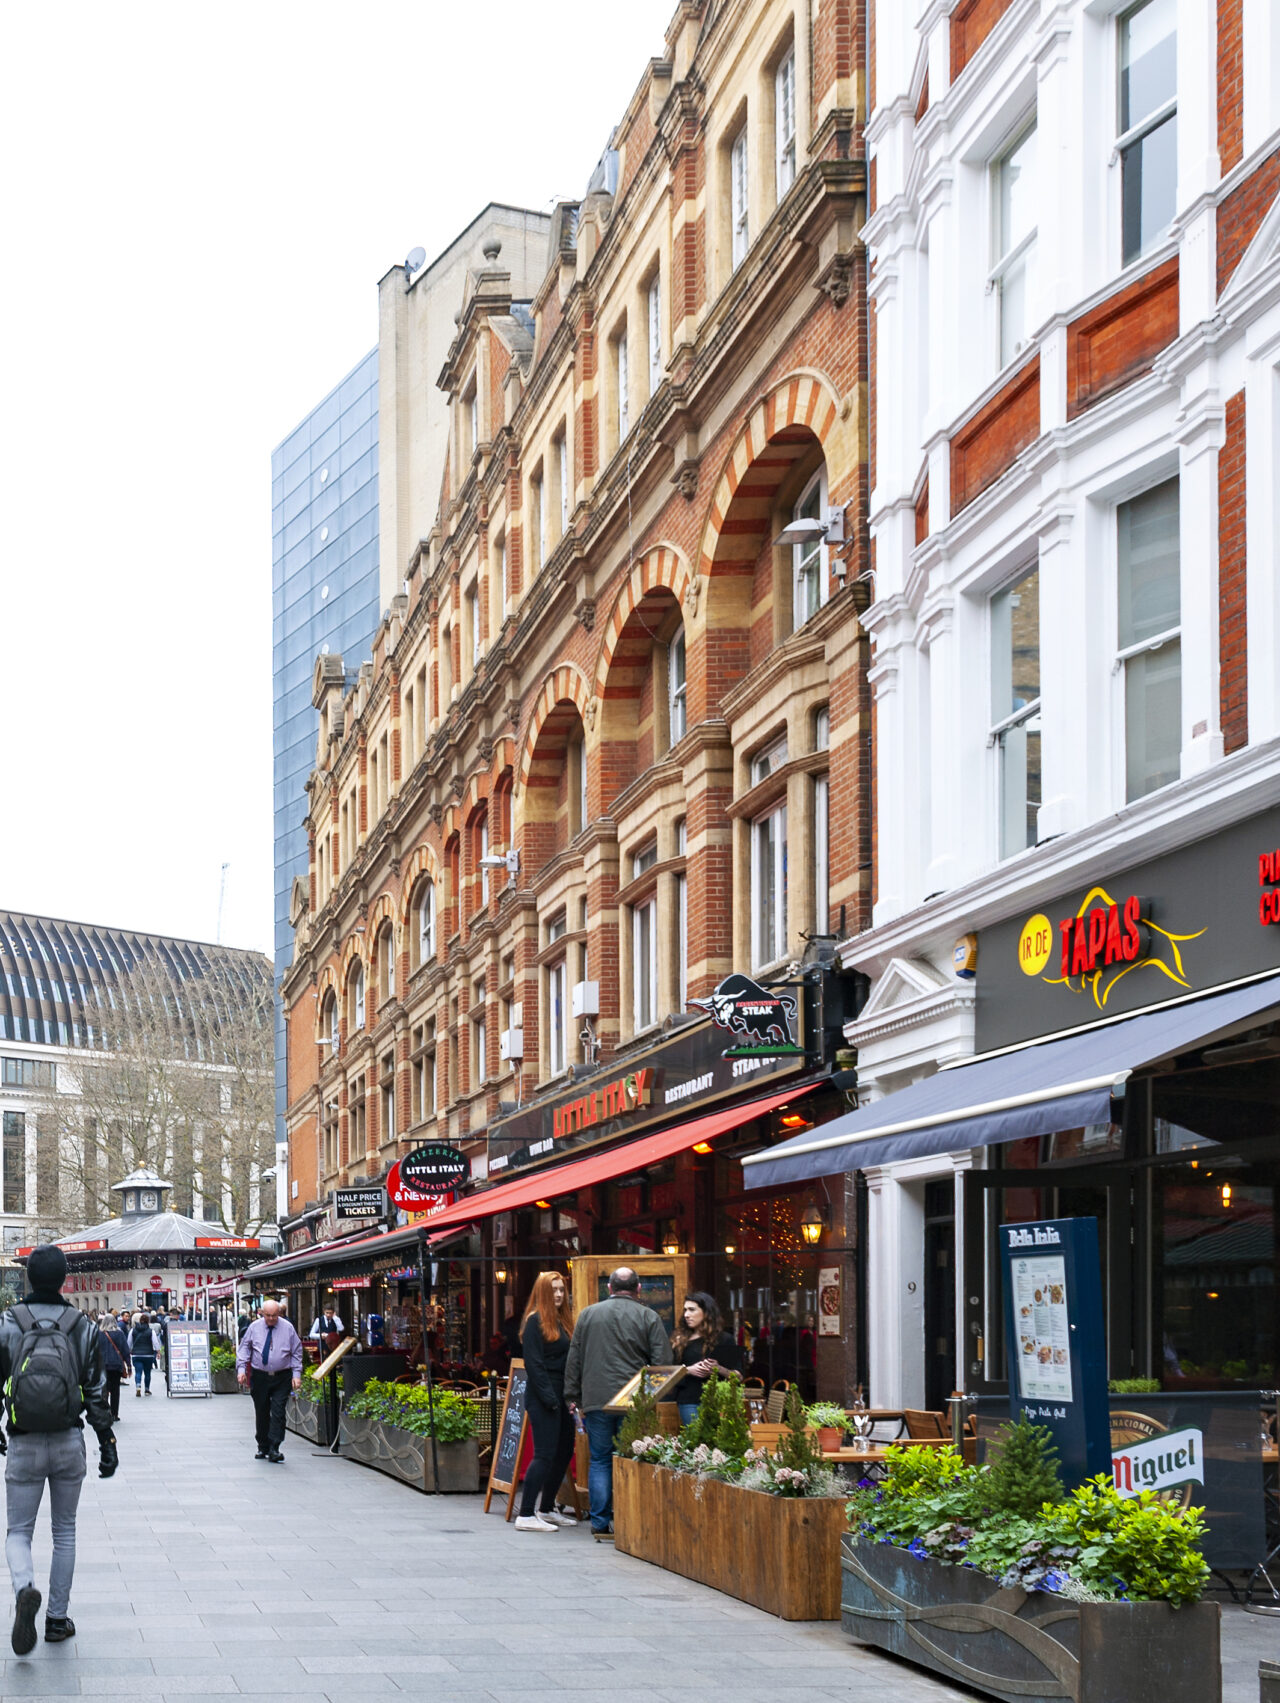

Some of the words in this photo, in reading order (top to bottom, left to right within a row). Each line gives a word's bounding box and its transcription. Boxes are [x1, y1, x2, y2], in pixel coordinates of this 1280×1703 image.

[1022, 937, 1032, 961] IR
[1035, 928, 1048, 957] DE
[1059, 895, 1140, 978] TAPAS
[742, 1006, 773, 1016] STEAK
[732, 1058, 760, 1078] STEAK
[664, 1072, 714, 1104] RESTAURANT
[553, 1092, 597, 1139] LITTLE
[410, 1147, 460, 1164] PIZZERIA
[406, 1166, 436, 1175] LITTLE
[439, 1164, 465, 1173] ITALY
[411, 1174, 463, 1191] RESTAURANT
[337, 1194, 358, 1202] HALF
[359, 1193, 381, 1201] PRICE
[394, 1191, 402, 1201] &
[404, 1191, 438, 1201] NEWS
[344, 1206, 376, 1215] TICKETS
[209, 1239, 247, 1248] www.TKTS.co.uk
[1008, 1228, 1034, 1248] Bella
[1033, 1226, 1061, 1245] Italia
[907, 1281, 917, 1295] 9
